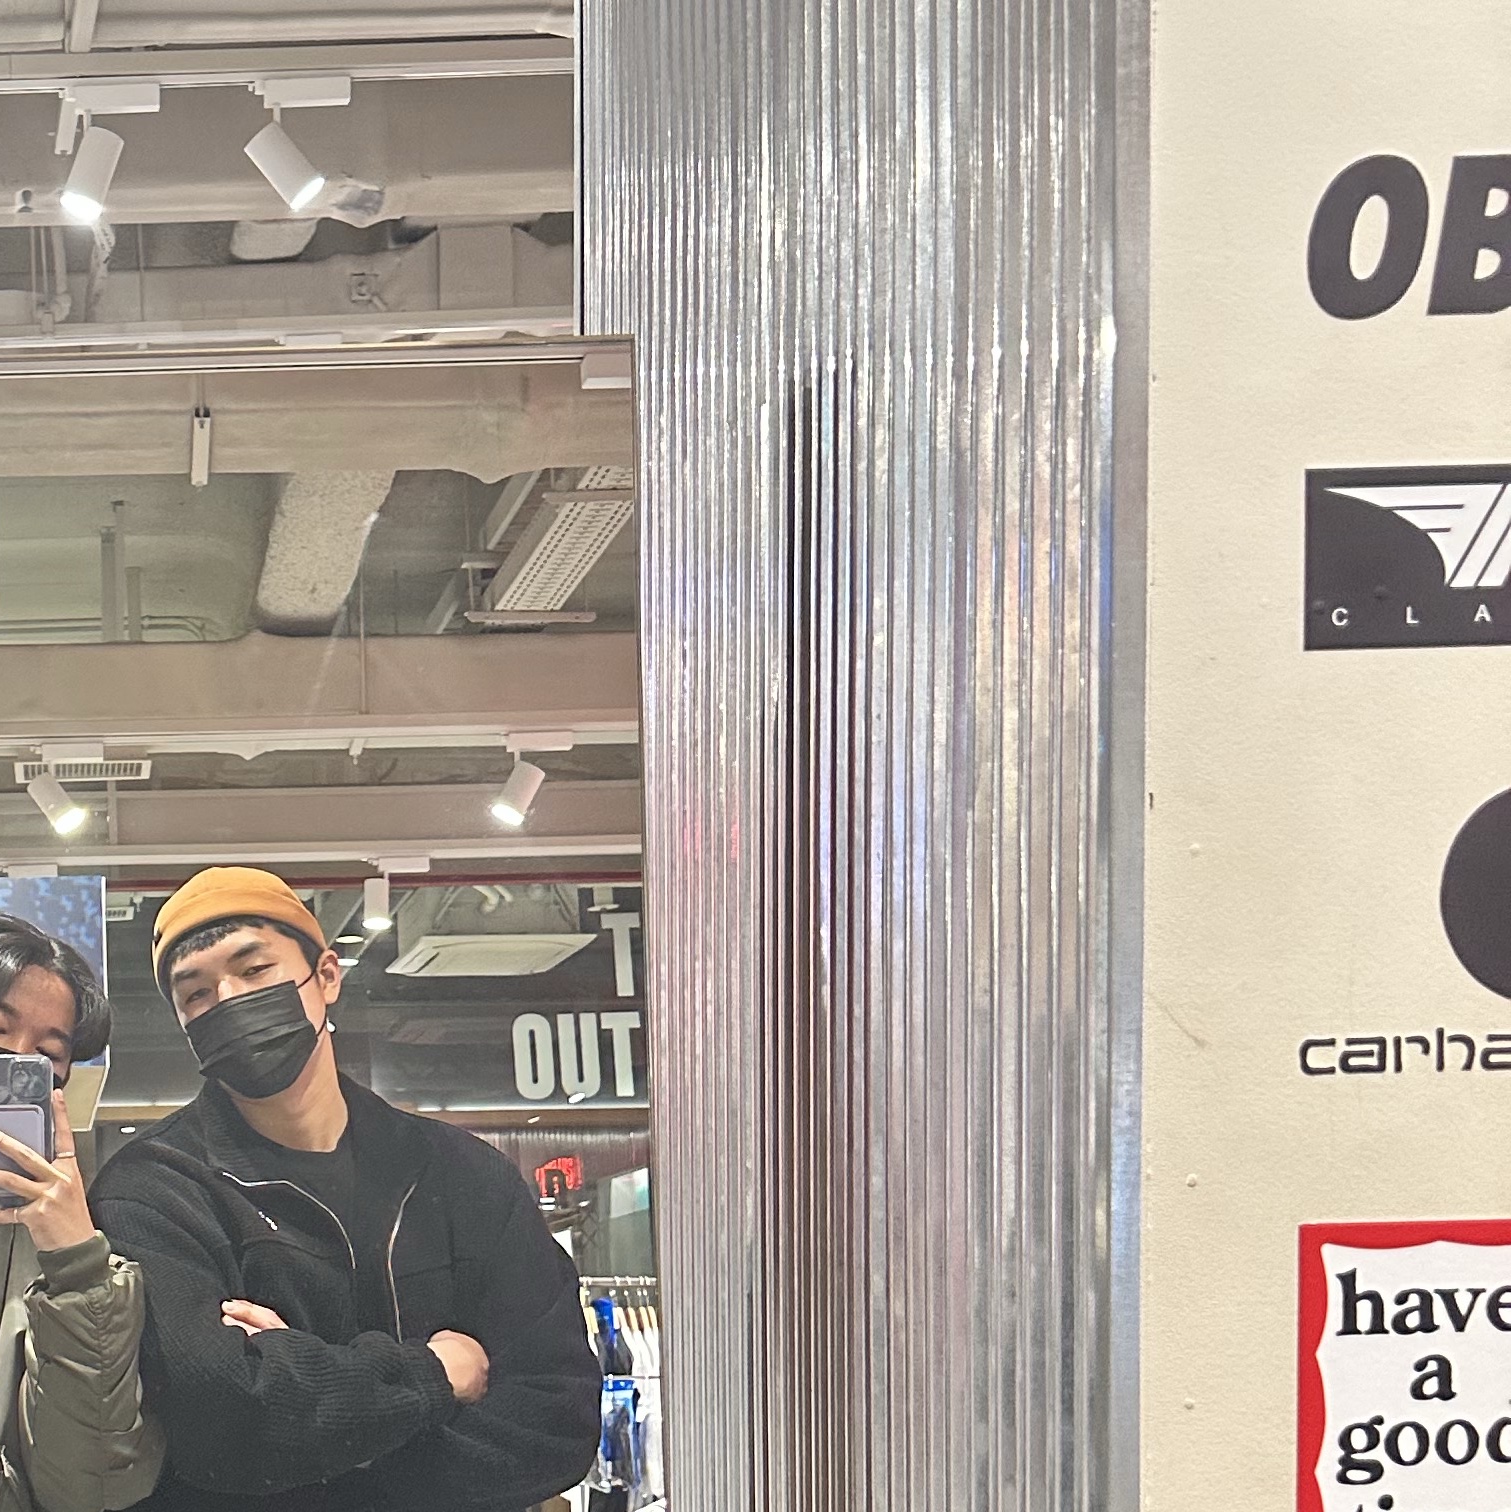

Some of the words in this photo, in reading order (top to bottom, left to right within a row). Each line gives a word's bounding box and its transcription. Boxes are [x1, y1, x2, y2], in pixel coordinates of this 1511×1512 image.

[1307, 152, 1511, 320] OB
[511, 1011, 642, 1101] OUT
[1299, 1026, 1511, 1077] carha
[1335, 1267, 1511, 1337] have
[1409, 1352, 1457, 1402] a
